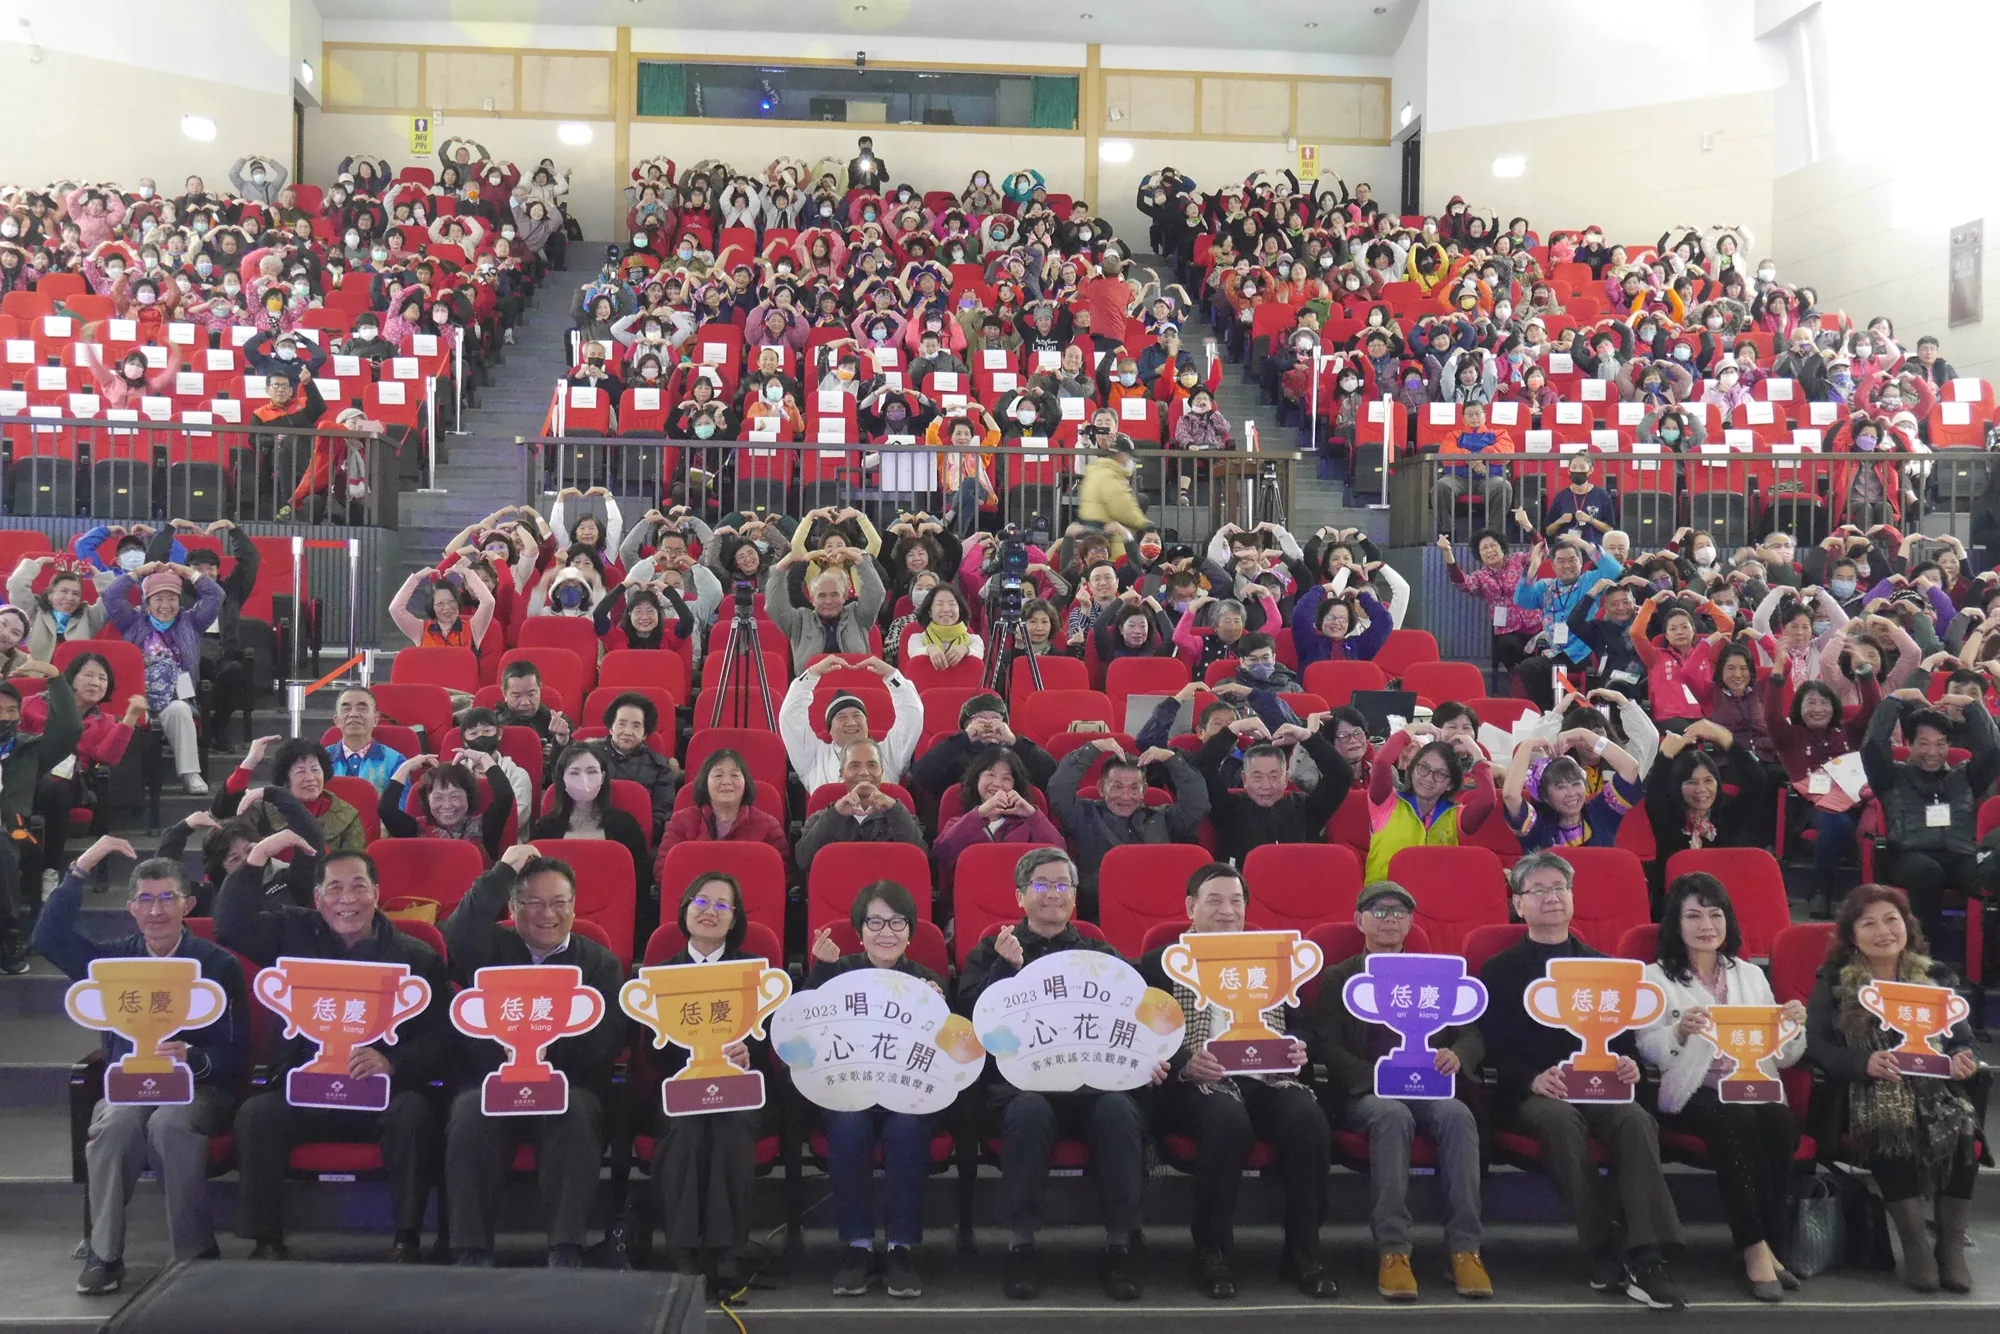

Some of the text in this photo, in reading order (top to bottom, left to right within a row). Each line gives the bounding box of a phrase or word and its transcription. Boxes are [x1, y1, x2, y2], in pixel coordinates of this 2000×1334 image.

[1218, 965, 1269, 990] 恁慶
[117, 990, 173, 1014] 恁慶
[1003, 974, 1111, 1009] 2023 唱 Do
[1390, 984, 1441, 1010] 恁慶
[1571, 988, 1621, 1013] 恁慶
[312, 997, 367, 1024] 恁慶
[500, 995, 554, 1021] 恁慶
[679, 999, 733, 1026] 恁慶
[803, 991, 912, 1025] 2023 唱 Do
[1031, 1050, 1141, 1072] 客家歌謠交流觀摩賽
[824, 1070, 936, 1095] 客家歌謠交流觀摩賽
